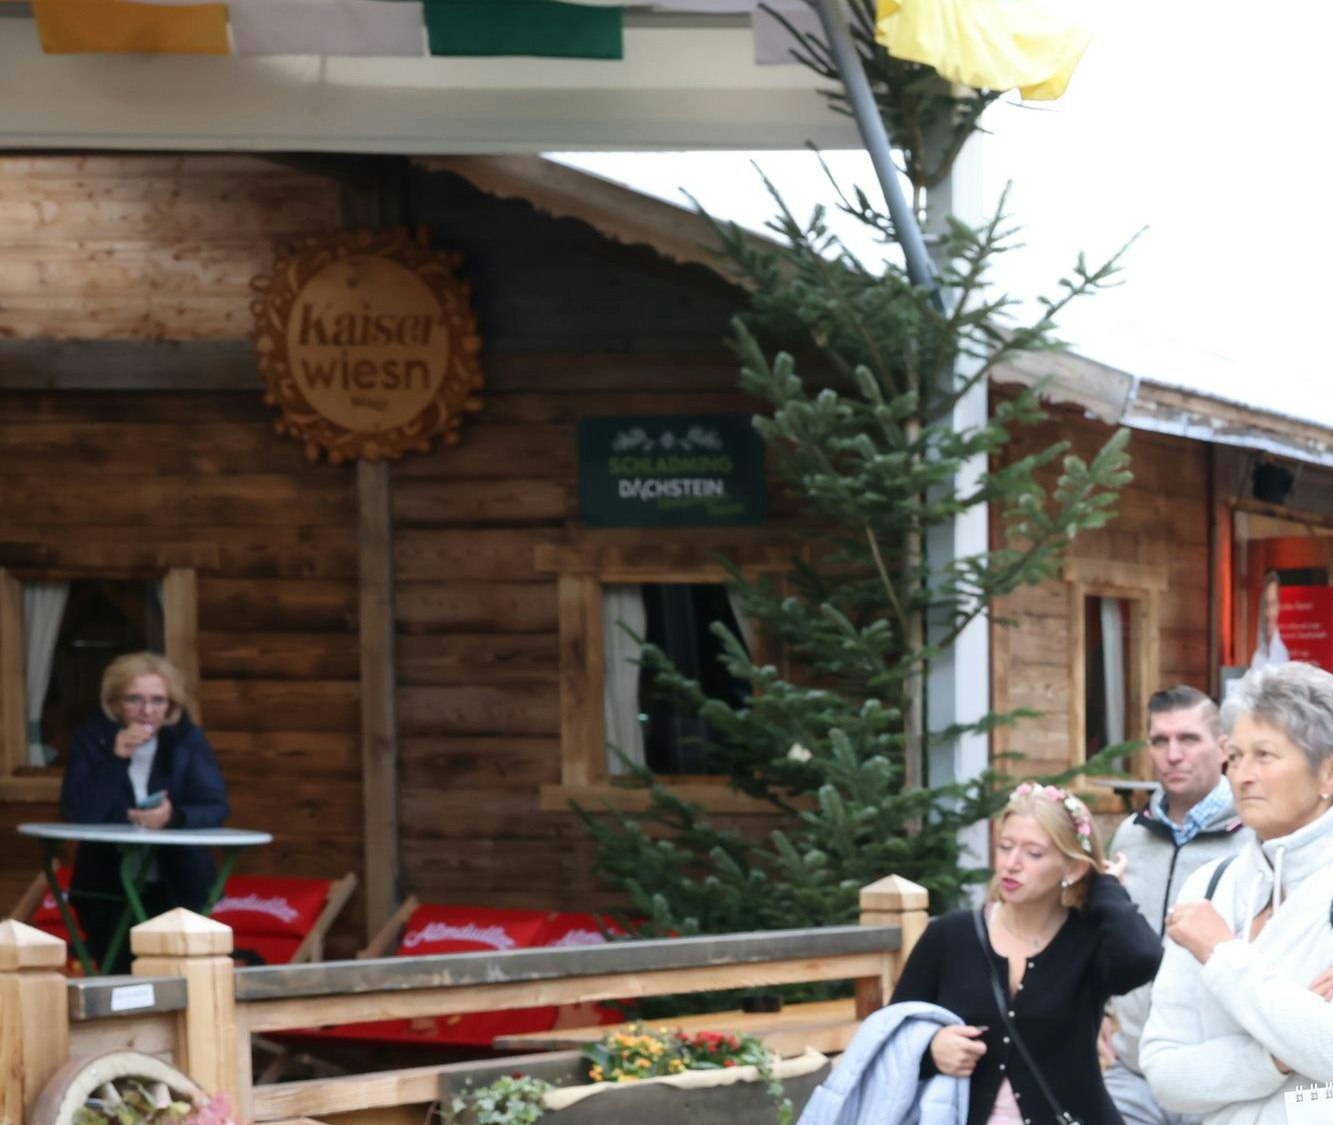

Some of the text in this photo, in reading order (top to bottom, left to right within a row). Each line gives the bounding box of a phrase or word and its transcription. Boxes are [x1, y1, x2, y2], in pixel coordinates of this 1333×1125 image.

[302, 350, 431, 390] wiesn
[608, 455, 734, 475] SCHLADMING
[618, 478, 725, 501] DACHSTEIN
